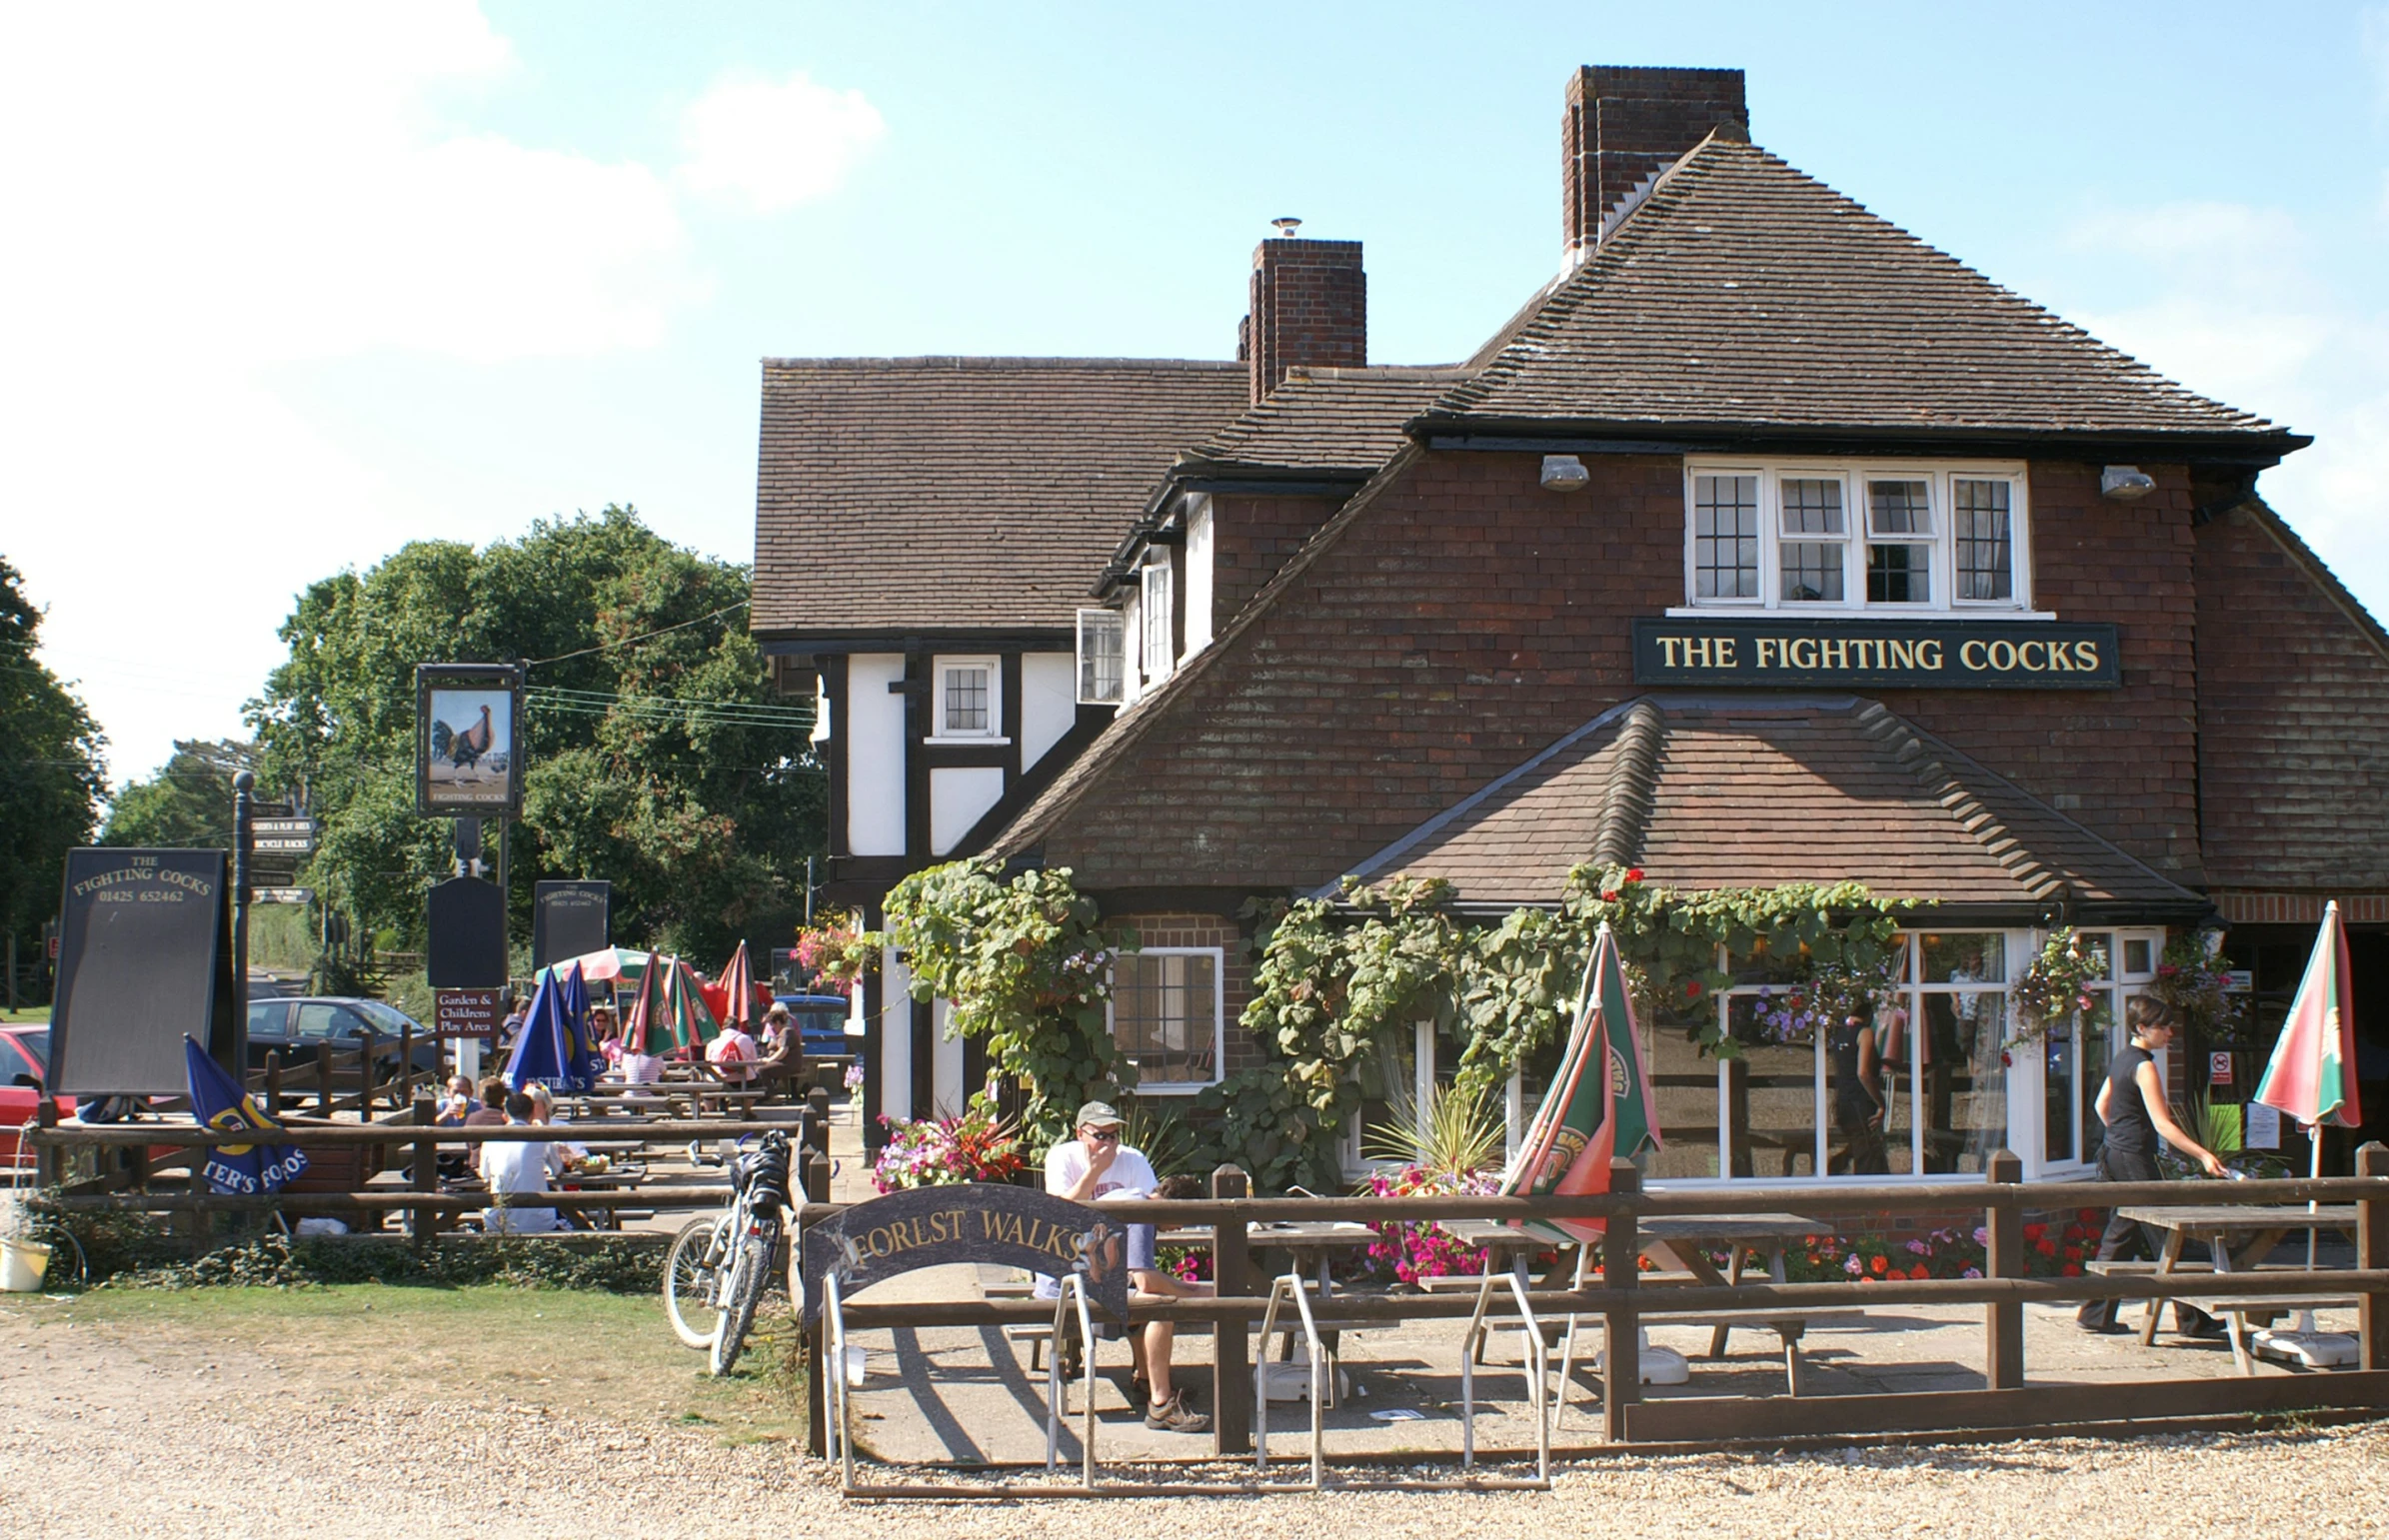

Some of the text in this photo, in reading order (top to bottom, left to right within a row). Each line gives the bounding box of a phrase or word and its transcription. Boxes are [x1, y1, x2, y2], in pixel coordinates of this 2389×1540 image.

[1655, 637, 2099, 672] THE FIGHTING COCKS
[433, 792, 506, 801] FIGHTING COCKS
[132, 856, 158, 866] THE
[73, 867, 211, 896] FIGHTING COCKS
[99, 890, 184, 902] 01425 652462
[439, 993, 492, 1005] Garden &
[440, 1007, 491, 1018] Childrens
[441, 1020, 491, 1032] Play Area
[852, 1209, 1086, 1265] FOREST WALKS
